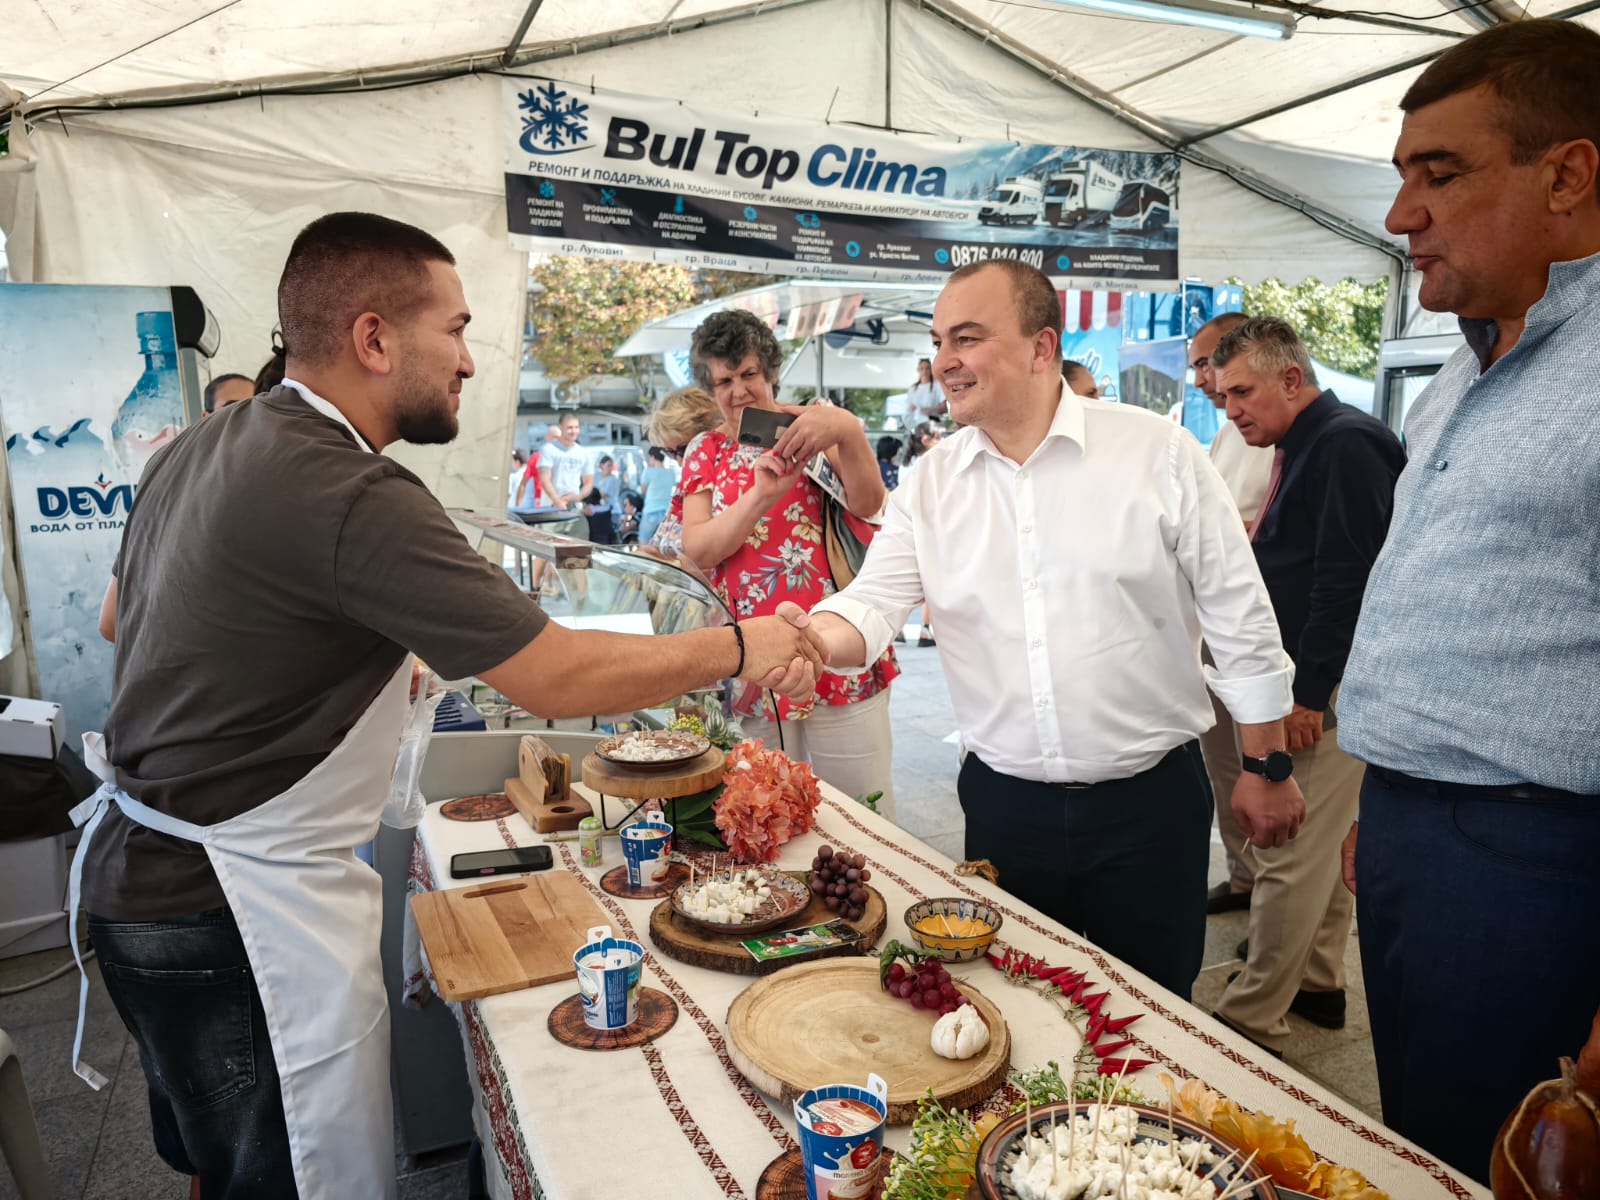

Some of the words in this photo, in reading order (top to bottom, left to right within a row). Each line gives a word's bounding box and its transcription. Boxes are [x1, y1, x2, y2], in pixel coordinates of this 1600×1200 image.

[603, 116, 706, 172] Bul
[713, 130, 800, 190] Top
[807, 143, 947, 197] Clima
[528, 160, 579, 177] РЕМОНТ
[581, 169, 590, 179] И
[593, 169, 671, 188] ПОДДРЪЖКА
[673, 180, 685, 190] НА
[815, 199, 863, 211] РЕМАРКЕТА
[864, 204, 870, 212] И
[871, 204, 919, 217] КЛИМАТИЦИ
[920, 207, 930, 216] НА
[931, 208, 969, 220] АВТОБУСИ
[527, 197, 554, 207] РЕМОНТ
[555, 200, 565, 209] НА
[528, 207, 564, 218] ХЛАДИЛНИ
[582, 203, 634, 216] ПРОФИЛАКТИКА
[530, 217, 562, 228] АГРЕГАТИ
[584, 214, 591, 222] И
[591, 214, 631, 225] ПОДДРЪЖКА
[657, 211, 704, 224] ДИАГНОСТИКА
[561, 243, 577, 252] гр.
[579, 243, 624, 256] Луковит
[685, 255, 700, 264] гр.
[703, 254, 737, 266] Враца
[951, 244, 988, 268] 0876
[795, 265, 809, 273] гр.
[812, 265, 849, 275] Плевен
[37, 484, 138, 518] DEVI
[30, 523, 71, 533] ВОДА
[75, 522, 94, 530] ОТ
